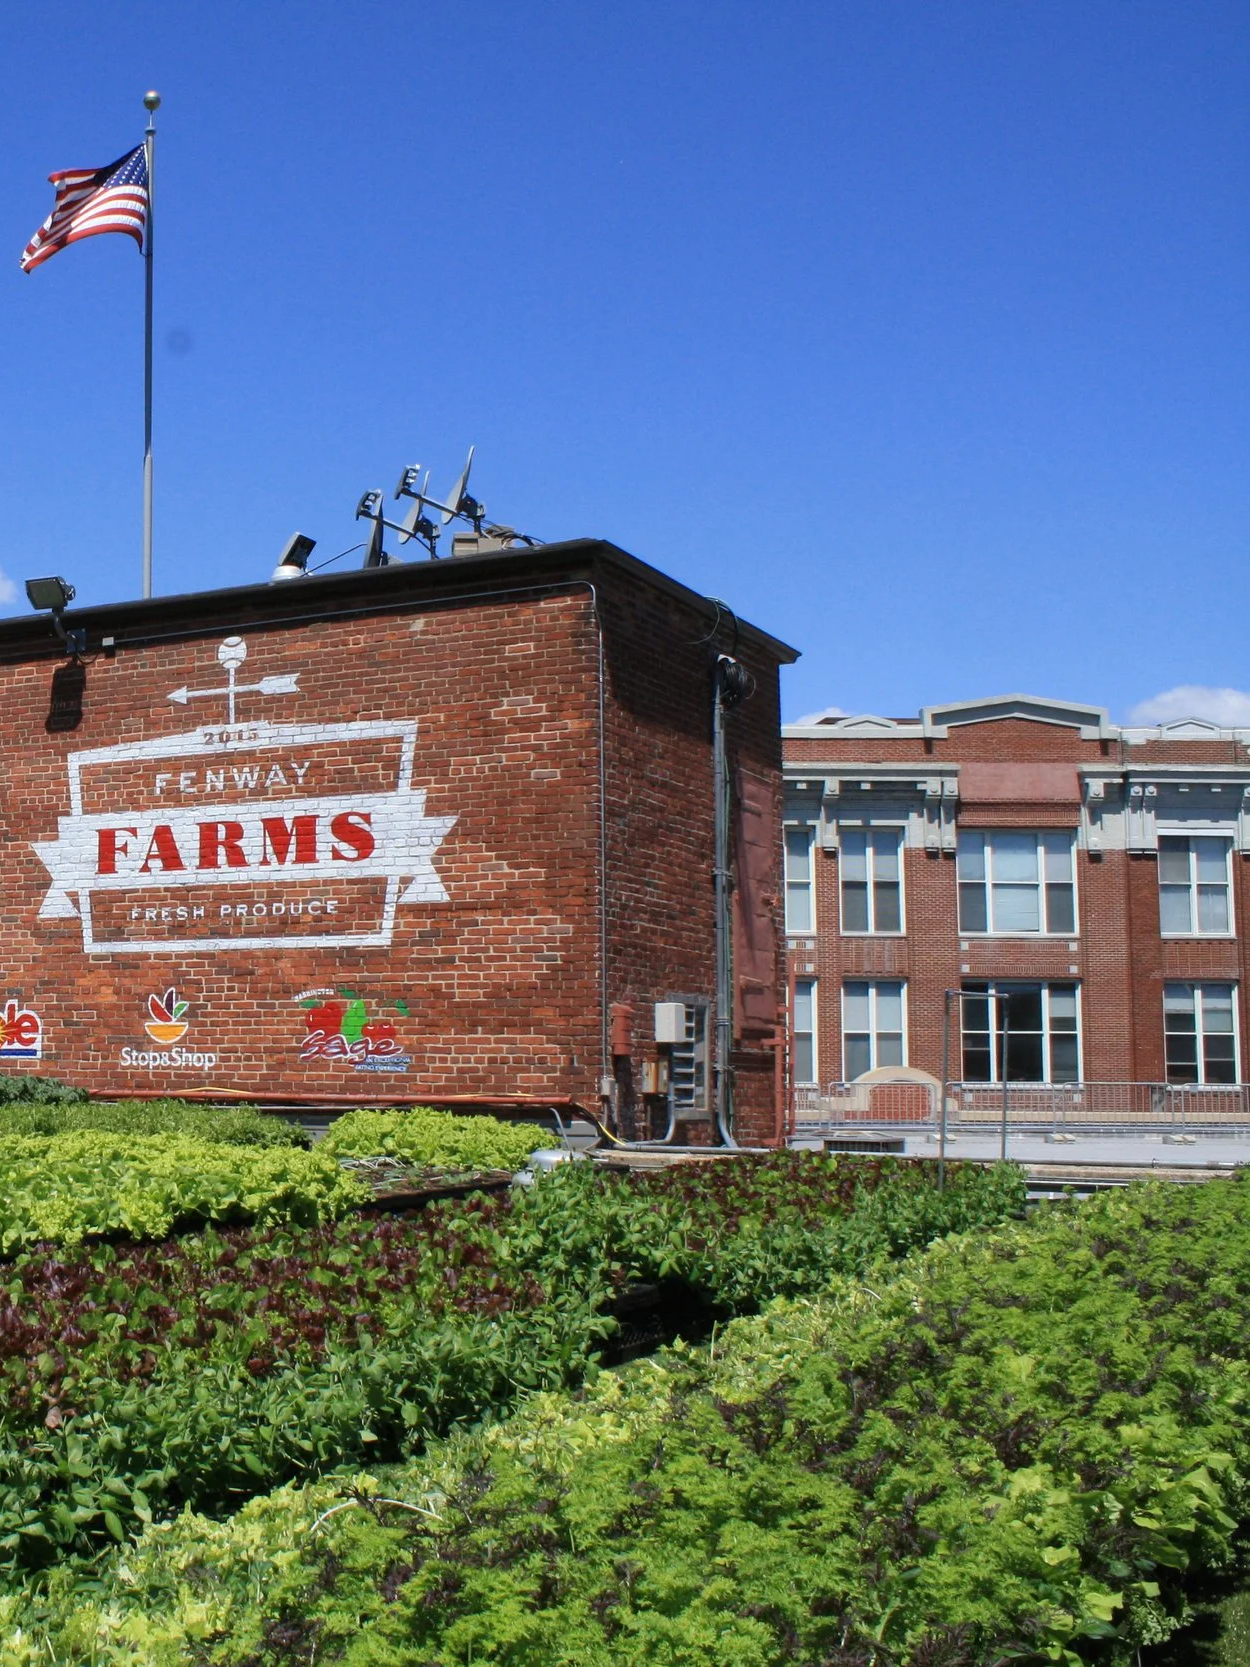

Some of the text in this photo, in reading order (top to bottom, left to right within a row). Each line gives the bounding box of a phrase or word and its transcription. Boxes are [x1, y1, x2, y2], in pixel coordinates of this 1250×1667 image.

[203, 728, 259, 746] 2015
[154, 761, 311, 795] FENWAY
[94, 811, 376, 875] FARMS
[130, 900, 339, 922] FRESH PRODUCE
[120, 1046, 217, 1071] Stop&Shop
